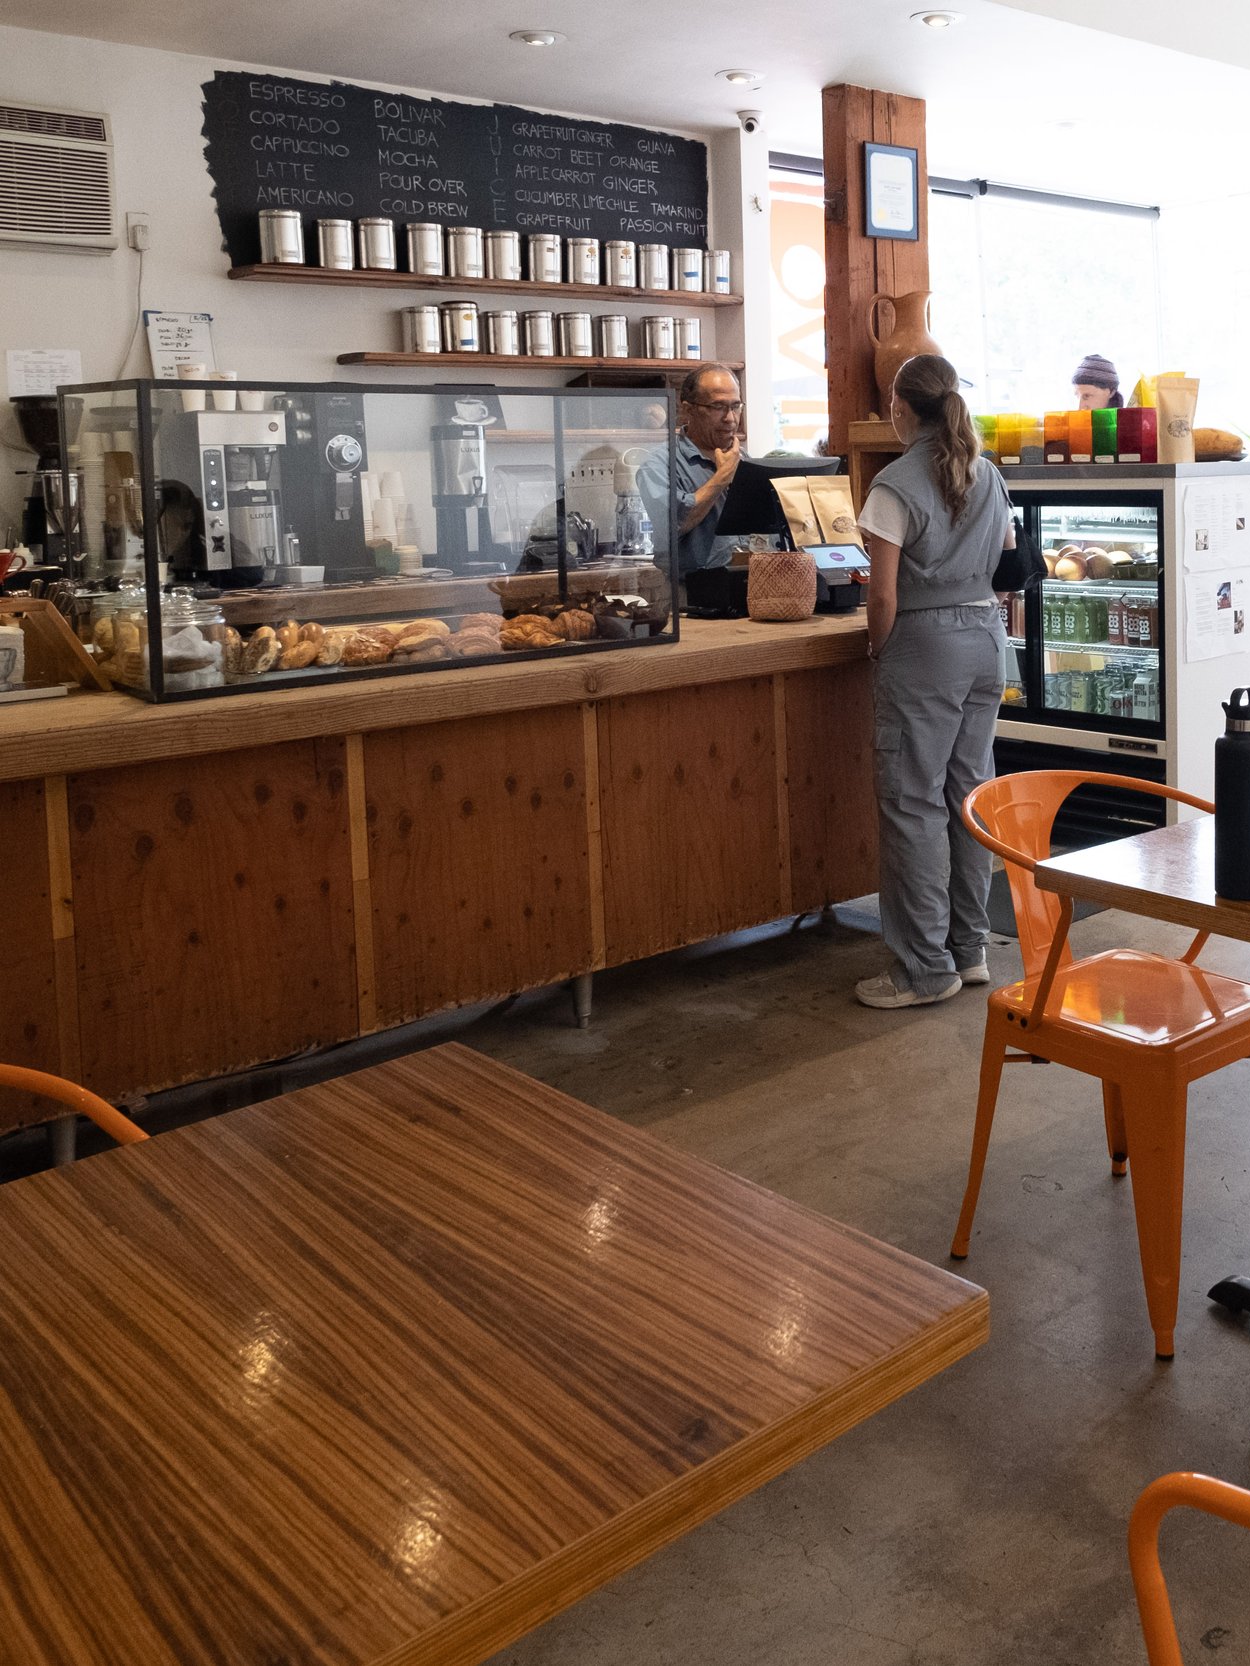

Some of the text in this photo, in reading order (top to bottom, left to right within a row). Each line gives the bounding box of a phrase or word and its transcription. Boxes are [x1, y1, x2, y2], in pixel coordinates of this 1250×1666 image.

[249, 82, 346, 108] ESPRESSO
[250, 110, 340, 135] CORTADO
[374, 99, 446, 128] BOLIVAR
[250, 135, 350, 158] CAPPUCCINO
[377, 125, 440, 148] TACUBA
[512, 123, 614, 149] GRAPEFRUIT GINGER
[378, 149, 439, 169] MOCHA
[513, 144, 661, 175] CARROT BEET ORANGE
[637, 139, 677, 158] GUAVA
[255, 160, 316, 182] LATTE
[486, 115, 507, 224] JUICE
[514, 164, 659, 196] APPLE CARROT GINGER
[379, 172, 468, 198] POUR OVER
[256, 186, 355, 208] AMERICANO
[379, 198, 469, 218] COLD BREW
[514, 190, 640, 214] CUCUMBER LIME CHILE
[516, 212, 592, 231] GRAPEFRUIT
[651, 202, 704, 220] TAMARIND
[619, 217, 708, 238] PASSION FRUIT
